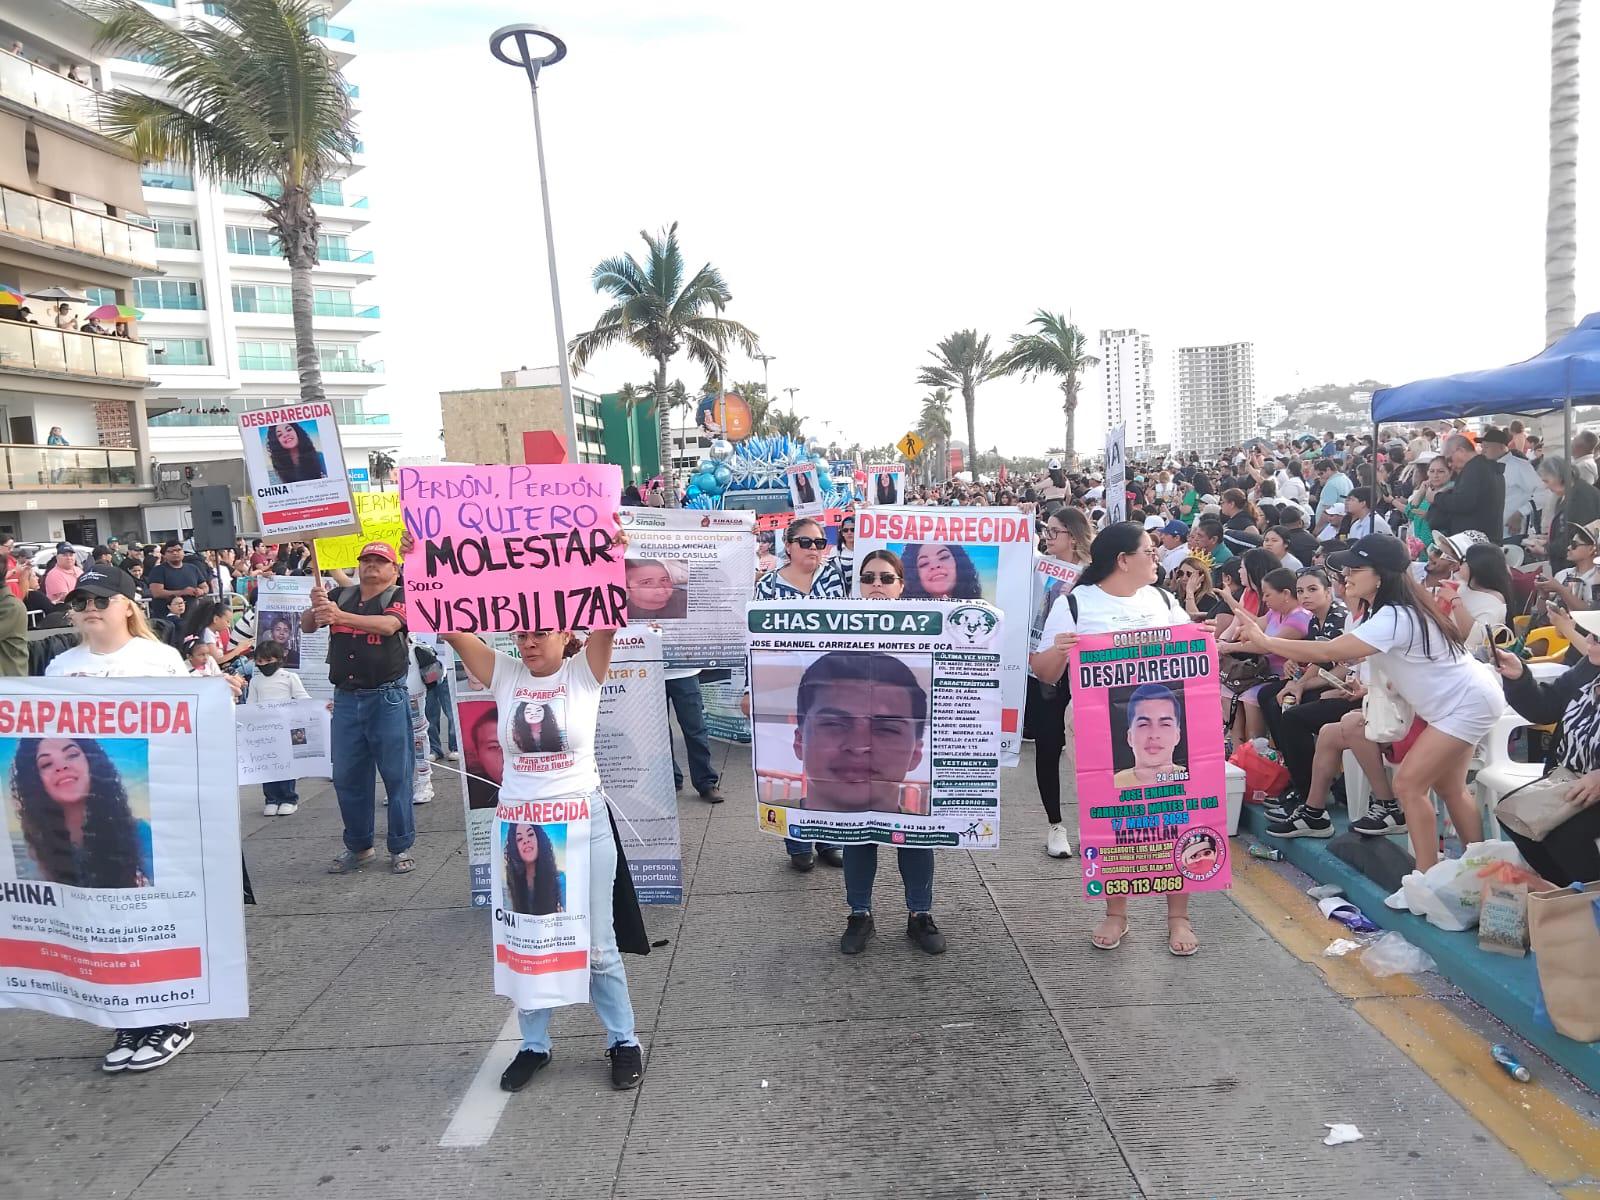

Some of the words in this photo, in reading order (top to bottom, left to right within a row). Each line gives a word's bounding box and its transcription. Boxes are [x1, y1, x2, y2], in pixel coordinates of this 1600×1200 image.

[241, 404, 332, 428] DESAPARECIDA
[257, 485, 289, 498] CHINA
[404, 504, 441, 540] NO
[458, 502, 598, 534] QUIERO
[635, 519, 666, 527] Sinaloa
[858, 513, 1030, 543] DESAPARECIDA
[426, 527, 616, 578] MOLESTAR
[407, 581, 443, 592] SOLO
[415, 583, 627, 633] VISIBILIZAR
[762, 613, 819, 630] ¿HAS
[825, 614, 895, 632] VISTO
[901, 615, 930, 632] A?
[367, 634, 382, 645] 01
[750, 640, 771, 648] JOSE
[774, 640, 816, 649] EMANUEL
[818, 641, 875, 649] CARRIZALES
[879, 642, 916, 650] MONTES
[919, 642, 931, 650] DE
[1114, 629, 1171, 646] COLECTIVO
[1080, 646, 1140, 664] BUSCANDOTE
[1141, 644, 1162, 657] LUIS
[1164, 641, 1188, 655] ALAN
[1190, 639, 1206, 653] SM
[638, 668, 647, 678] a
[1080, 654, 1210, 689] DESAPARECIDO
[1156, 773, 1167, 782] 24
[1119, 789, 1143, 802] JOSE
[1145, 784, 1186, 799] EMANUEL
[1090, 804, 1145, 818] CARRIZALES
[1148, 801, 1184, 815] MONTES
[1186, 799, 1199, 810] DE
[1201, 796, 1219, 808] OCA
[1111, 819, 1122, 831] 17
[1126, 815, 1160, 829] MARZO
[1163, 812, 1189, 825] 2025
[1116, 826, 1178, 844] MAZATLÁN
[642, 864, 679, 873] persona,
[632, 874, 679, 882] importante.
[1106, 880, 1129, 895] 638
[1131, 879, 1151, 894] 113
[1153, 877, 1183, 892] 4868
[96, 894, 131, 902] CECILIA
[135, 891, 197, 901] BERRELLEZA
[110, 903, 148, 911] FLORES
[12, 914, 32, 923] Vista
[34, 916, 47, 925] por
[85, 926, 94, 934] el
[109, 926, 121, 934] de
[123, 925, 147, 935] julio
[151, 923, 176, 932] 2025
[91, 935, 134, 943] Mazatlán
[138, 932, 177, 942] Sinaloa
[129, 959, 140, 968] al
[6, 976, 27, 988] ¡Su
[31, 978, 68, 995] familia
[82, 993, 129, 1006] extraña
[135, 989, 195, 1005] mucho!
